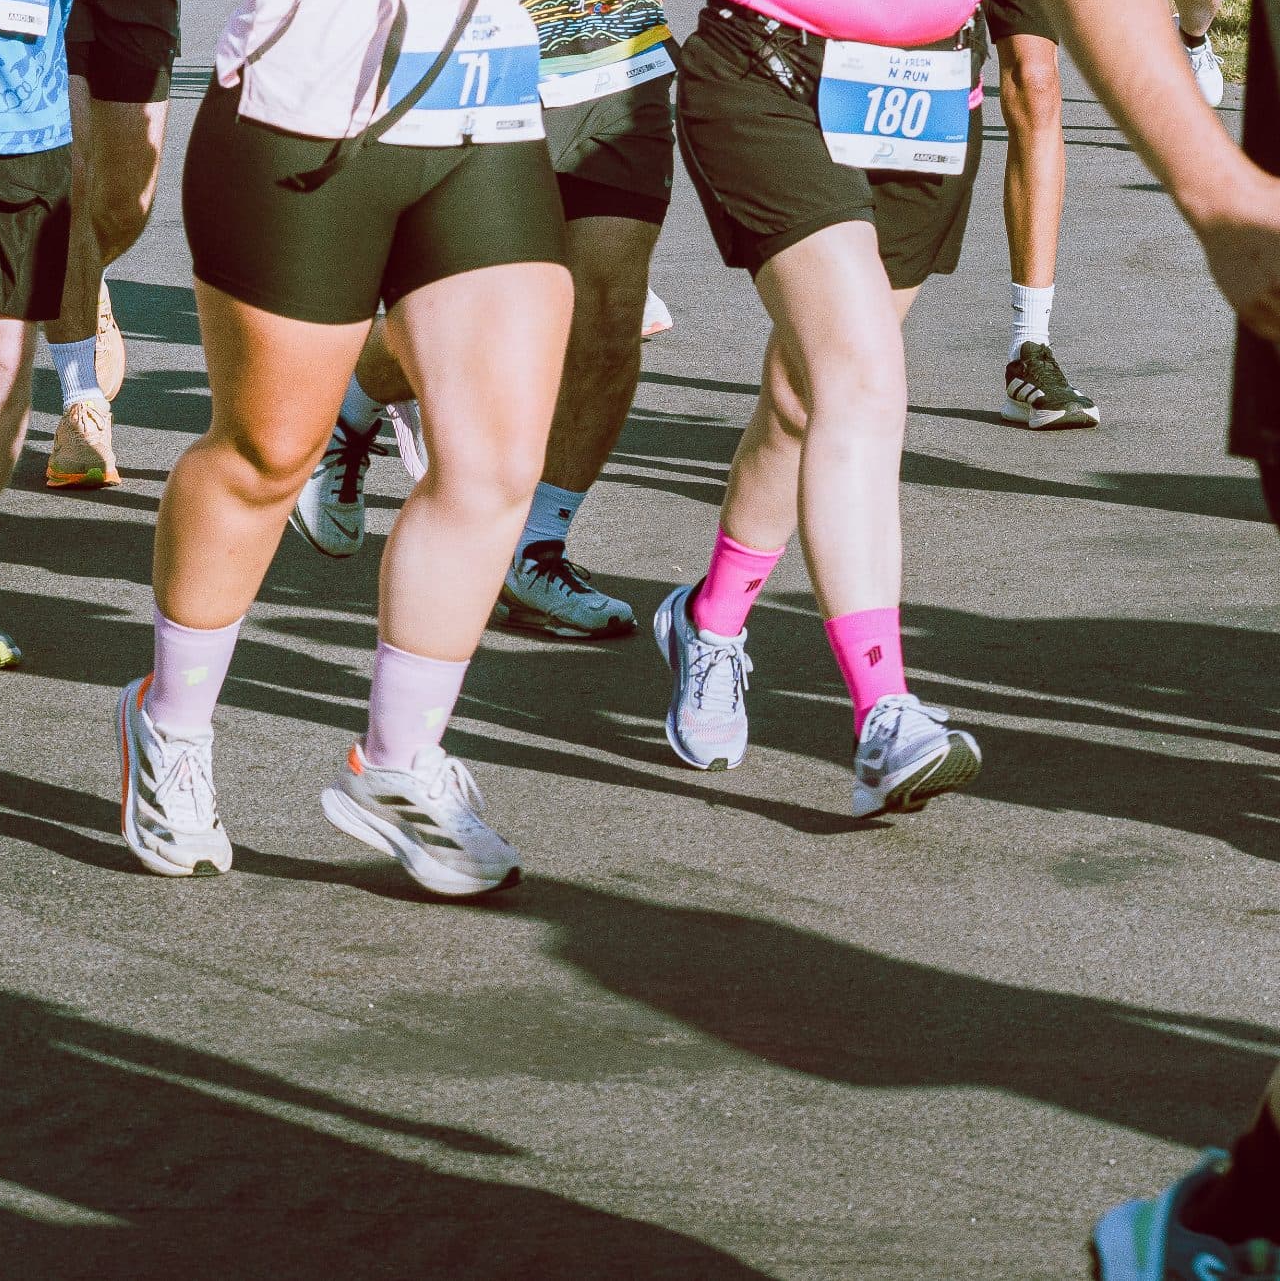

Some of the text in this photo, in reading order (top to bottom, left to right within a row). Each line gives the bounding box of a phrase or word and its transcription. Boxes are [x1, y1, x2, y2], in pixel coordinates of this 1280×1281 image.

[888, 68, 929, 82] N RUN
[890, 56, 900, 65] LA
[458, 52, 490, 106] 71
[864, 85, 932, 138] 180
